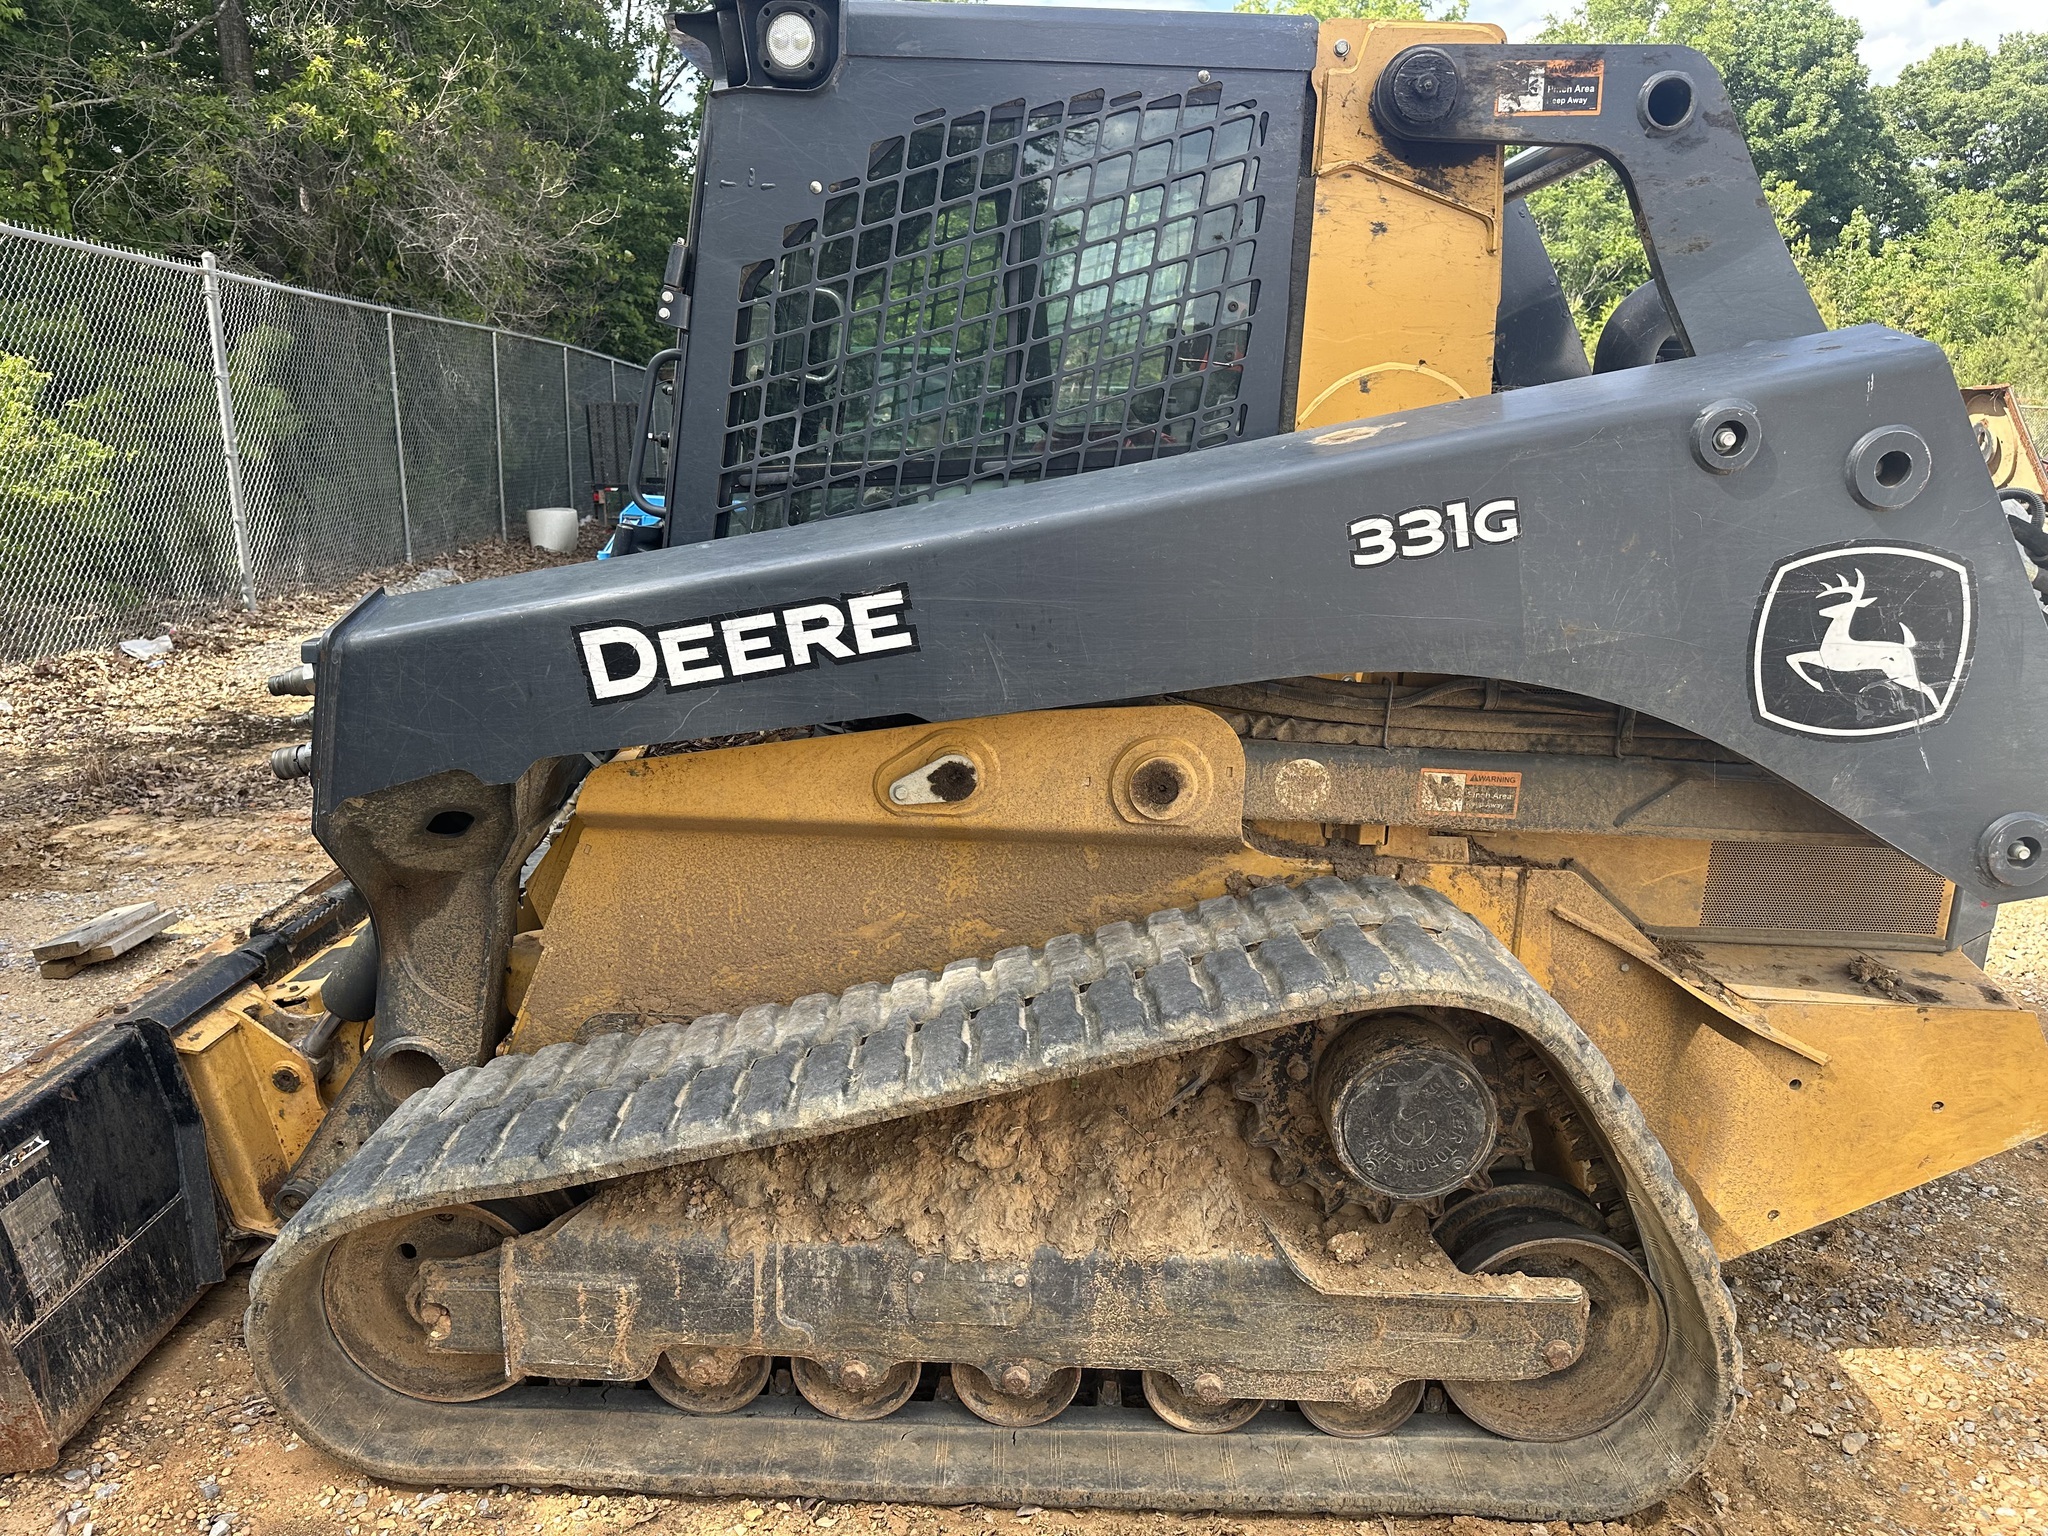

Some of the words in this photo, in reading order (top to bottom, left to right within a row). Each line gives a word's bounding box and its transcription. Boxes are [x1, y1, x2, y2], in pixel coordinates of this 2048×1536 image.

[1546, 96, 1566, 106] eep
[1566, 96, 1588, 106] Away
[1573, 84, 1596, 94] Area
[1349, 499, 1520, 567] 331G
[578, 589, 914, 701] DEERE
[1478, 775, 1517, 784] WARNING
[1426, 1081, 1468, 1145] SPICER
